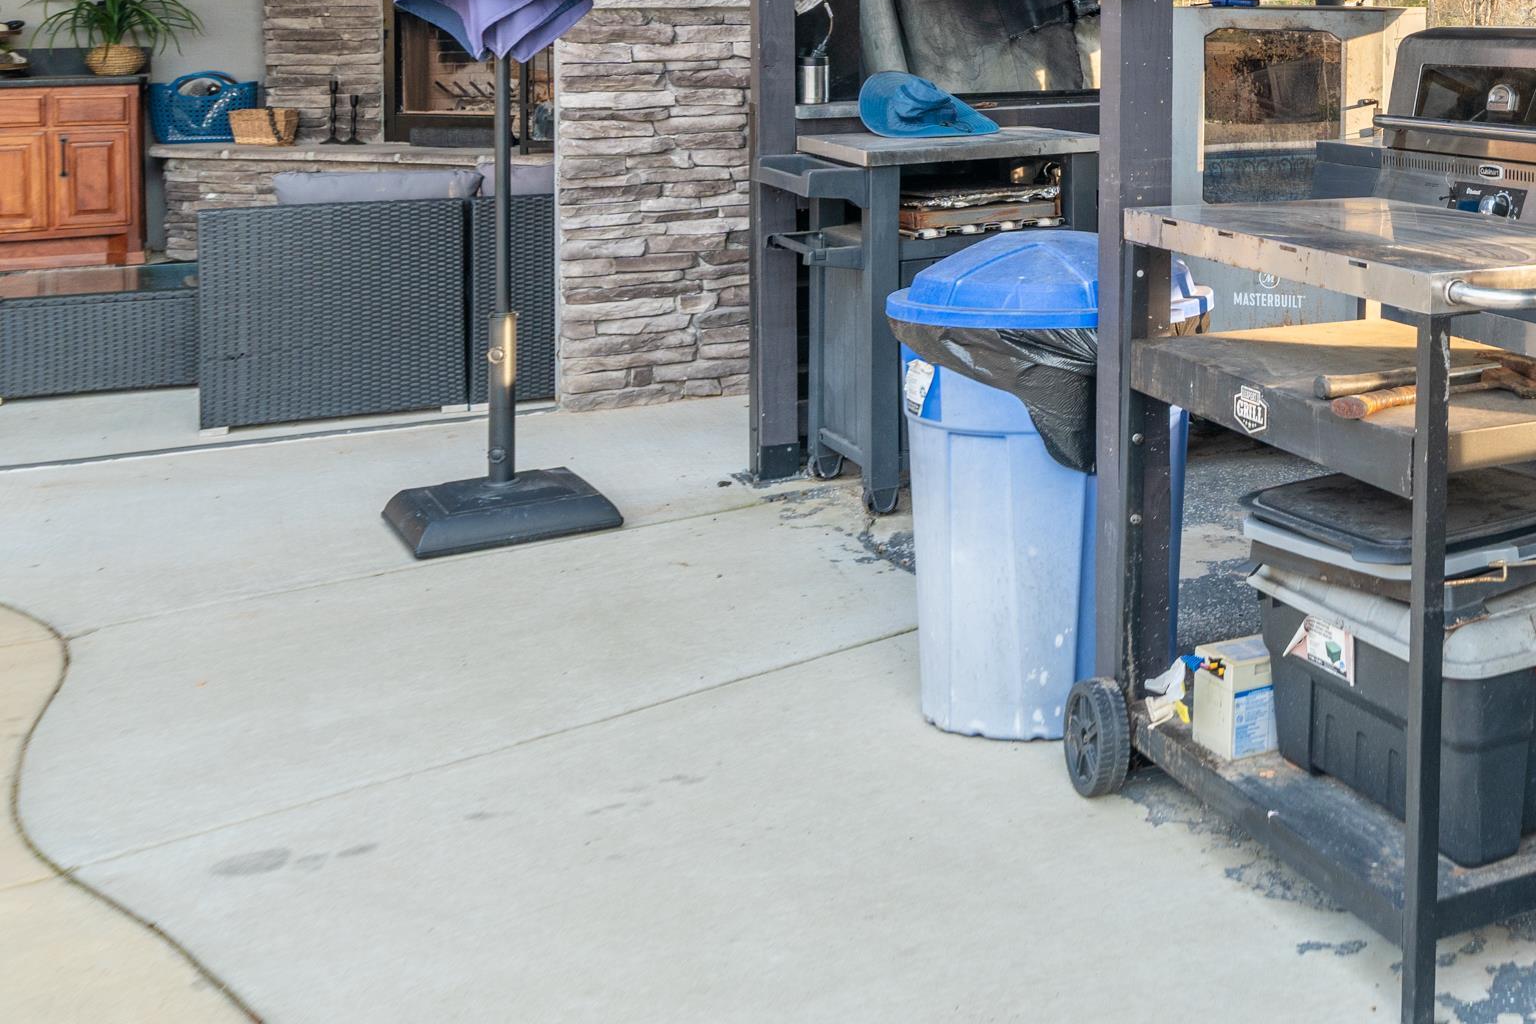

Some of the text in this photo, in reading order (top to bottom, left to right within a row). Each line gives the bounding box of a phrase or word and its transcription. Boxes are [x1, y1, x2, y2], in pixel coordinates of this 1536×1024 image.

[1480, 167, 1500, 177] Cuisinart
[1233, 291, 1302, 308] MASTERBUILT
[1236, 399, 1263, 424] GRILL
